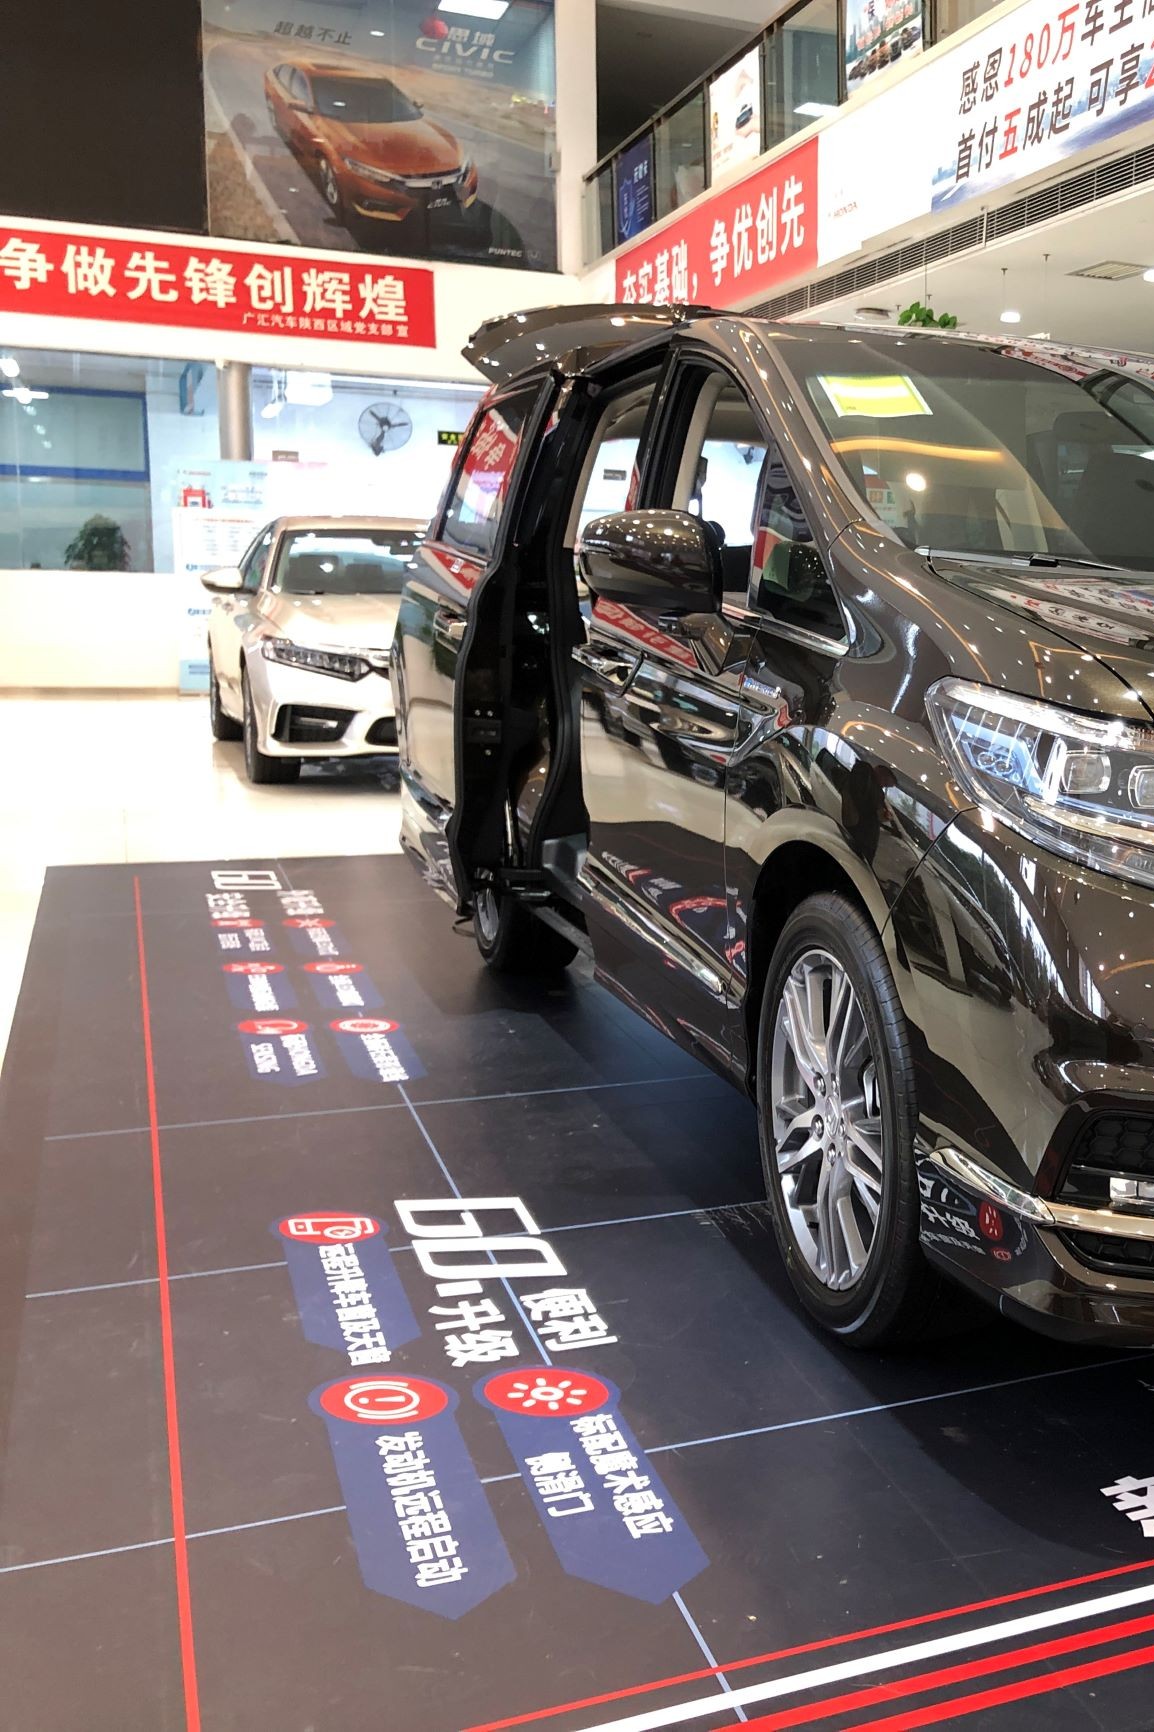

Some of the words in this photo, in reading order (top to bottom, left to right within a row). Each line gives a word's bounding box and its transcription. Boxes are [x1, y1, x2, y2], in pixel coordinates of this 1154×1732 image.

[274, 21, 352, 46] 超越不止
[416, 37, 515, 64] CIVIC
[956, 77, 1075, 183] 首付五成起
[0, 238, 409, 322] 争做先锋创辉煌
[428, 1298, 520, 1368] 升级
[520, 1287, 618, 1352] 便利
[375, 1431, 469, 1588] 发动机远程启动
[524, 1451, 596, 1518] 侧滑门
[569, 1413, 675, 1539] 标配魔术感应
